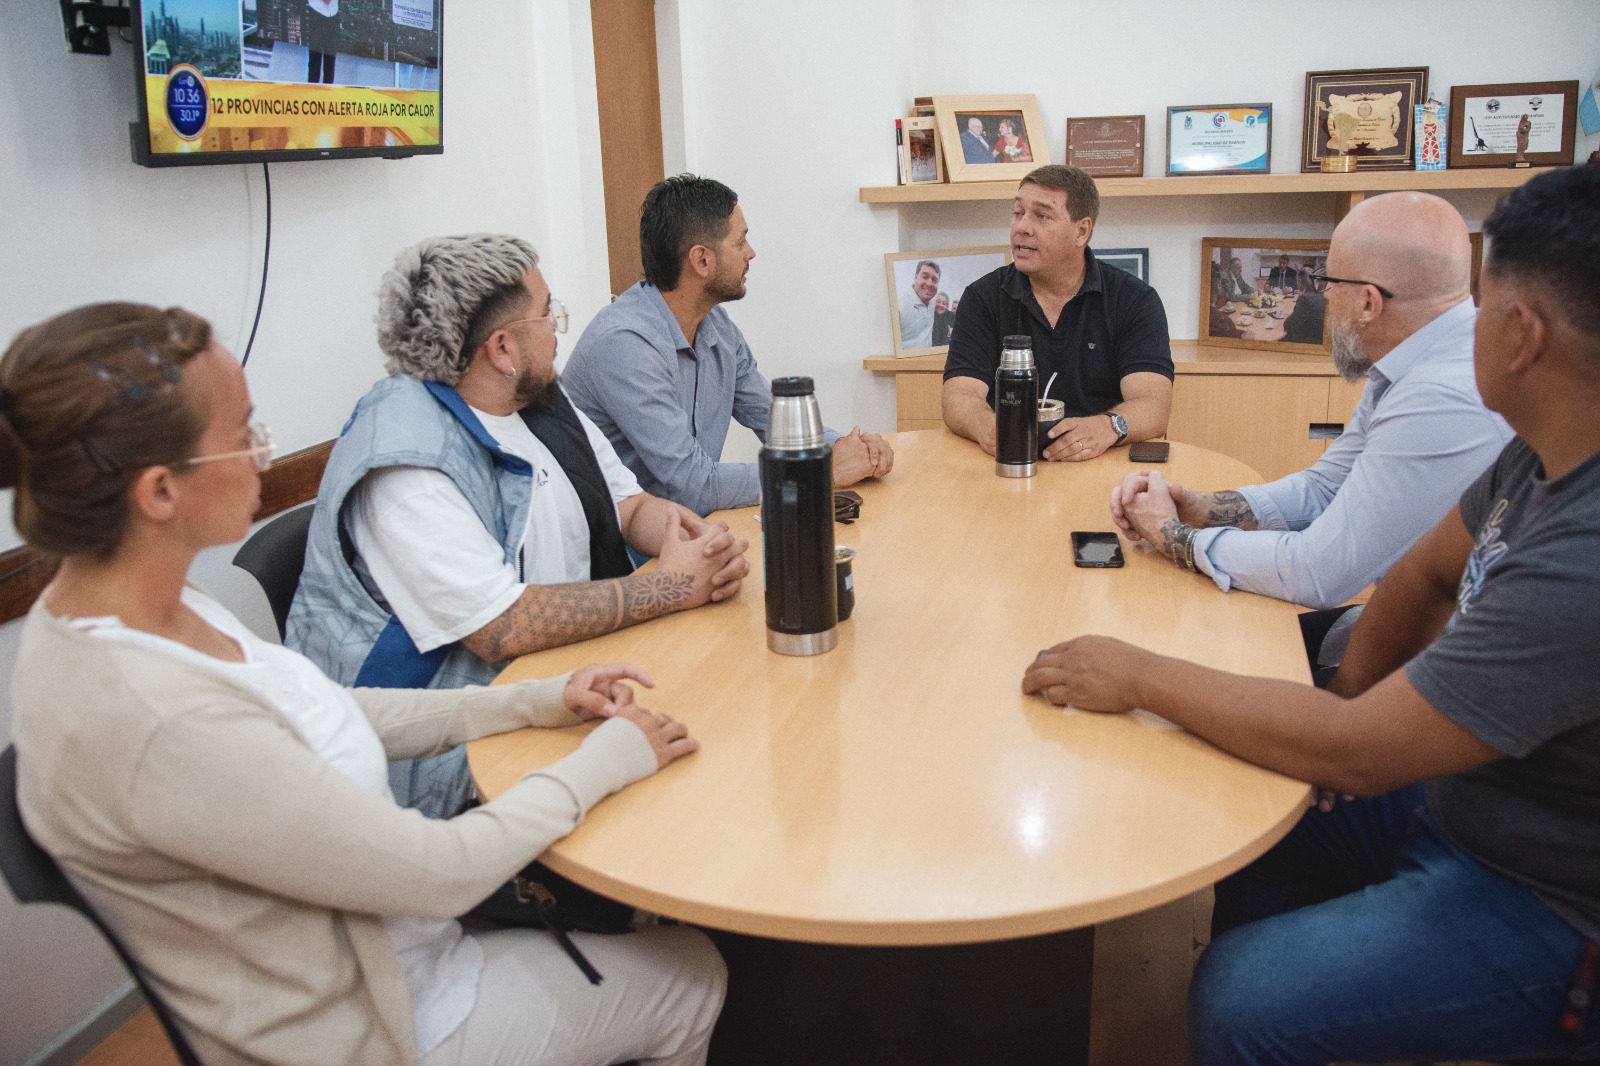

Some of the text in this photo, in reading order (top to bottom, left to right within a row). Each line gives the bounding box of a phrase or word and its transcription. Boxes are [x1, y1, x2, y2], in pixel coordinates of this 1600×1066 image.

[212, 98, 435, 117] 12 PROVINCIAS CON ALERTA ROJA POR CALOR
